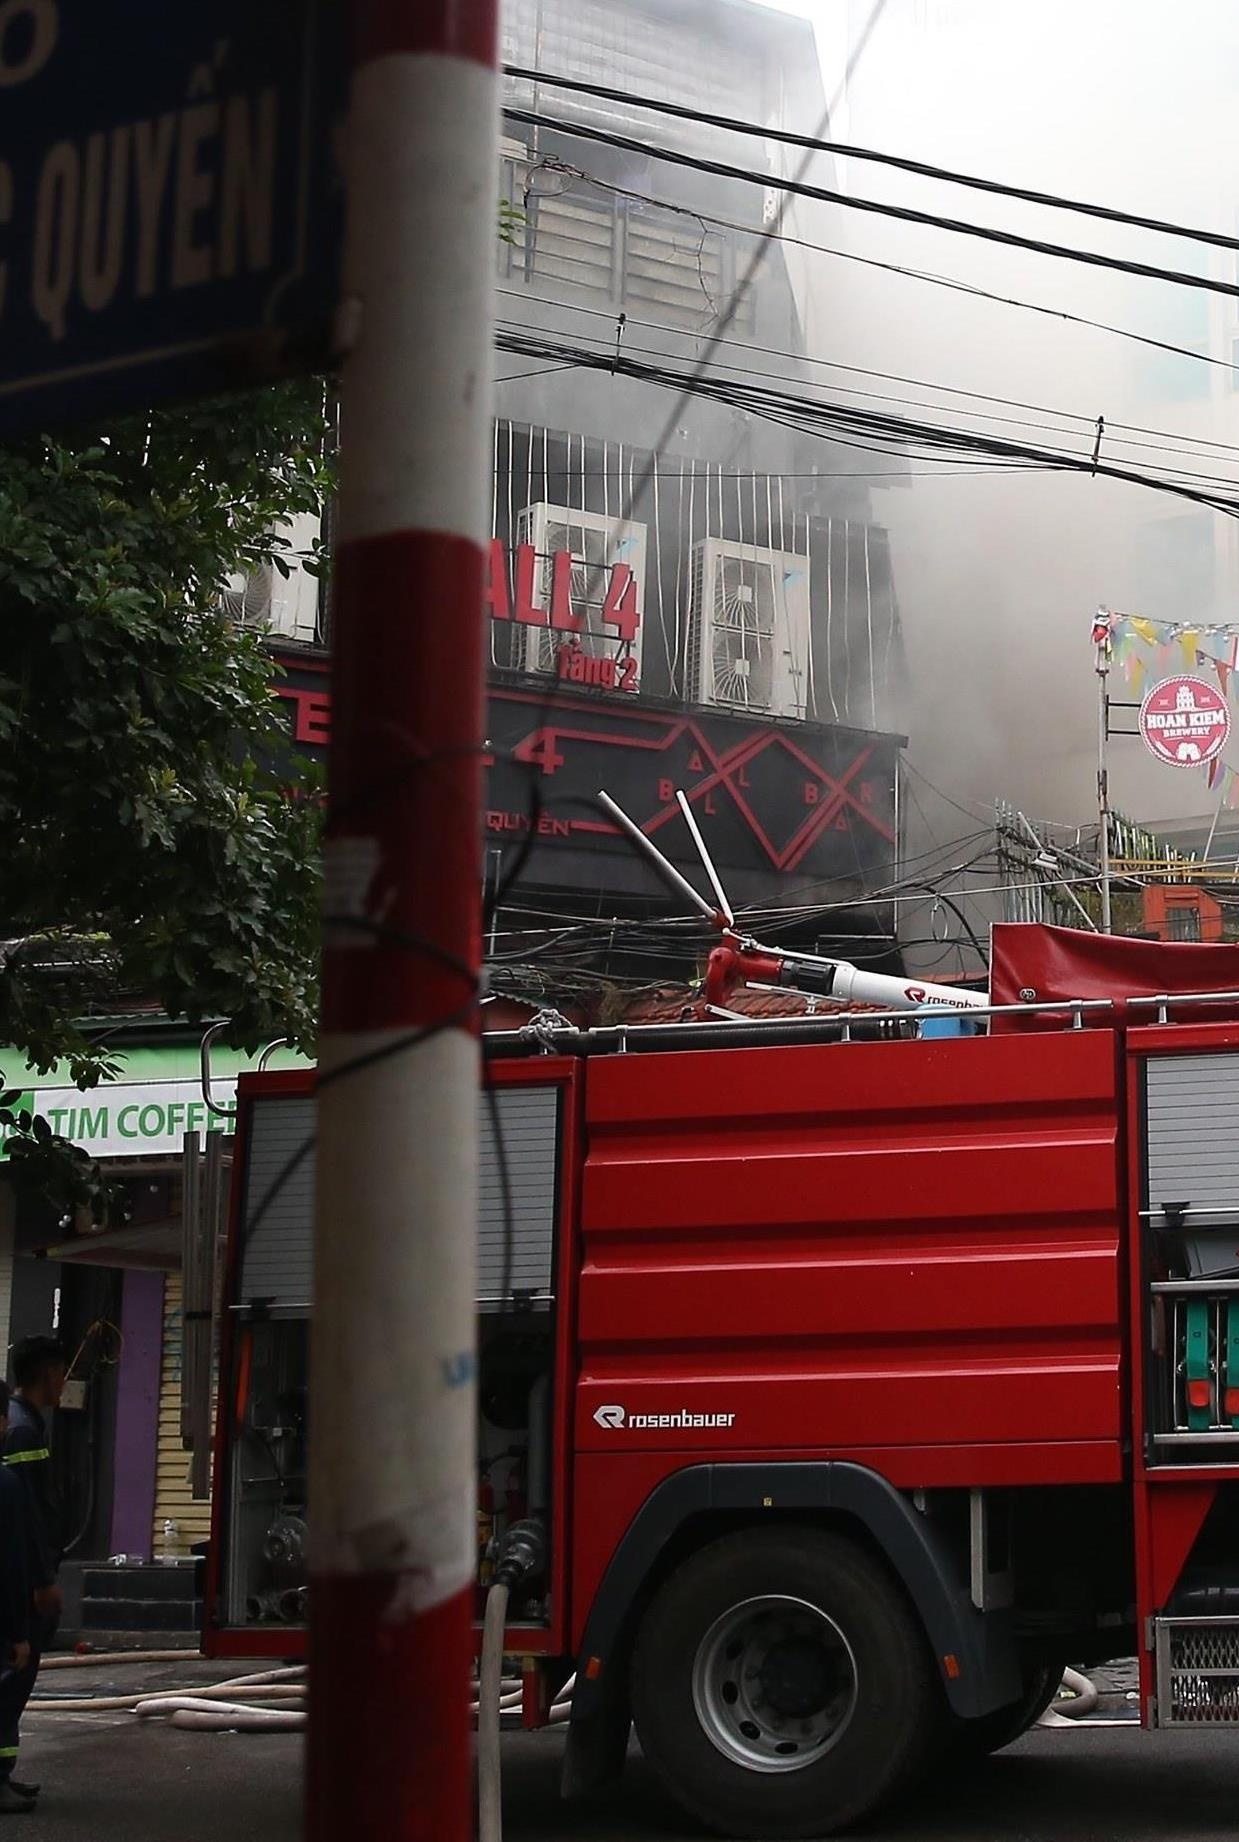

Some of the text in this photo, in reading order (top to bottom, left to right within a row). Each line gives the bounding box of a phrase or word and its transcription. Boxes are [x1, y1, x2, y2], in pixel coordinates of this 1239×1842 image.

[603, 563, 640, 641] 4
[620, 656, 639, 690] 2
[1146, 708, 1226, 730] HOAN KIEM
[1162, 726, 1211, 738] BREWERY
[47, 1106, 109, 1142] TIM
[628, 1408, 736, 1428] rosenbauer
